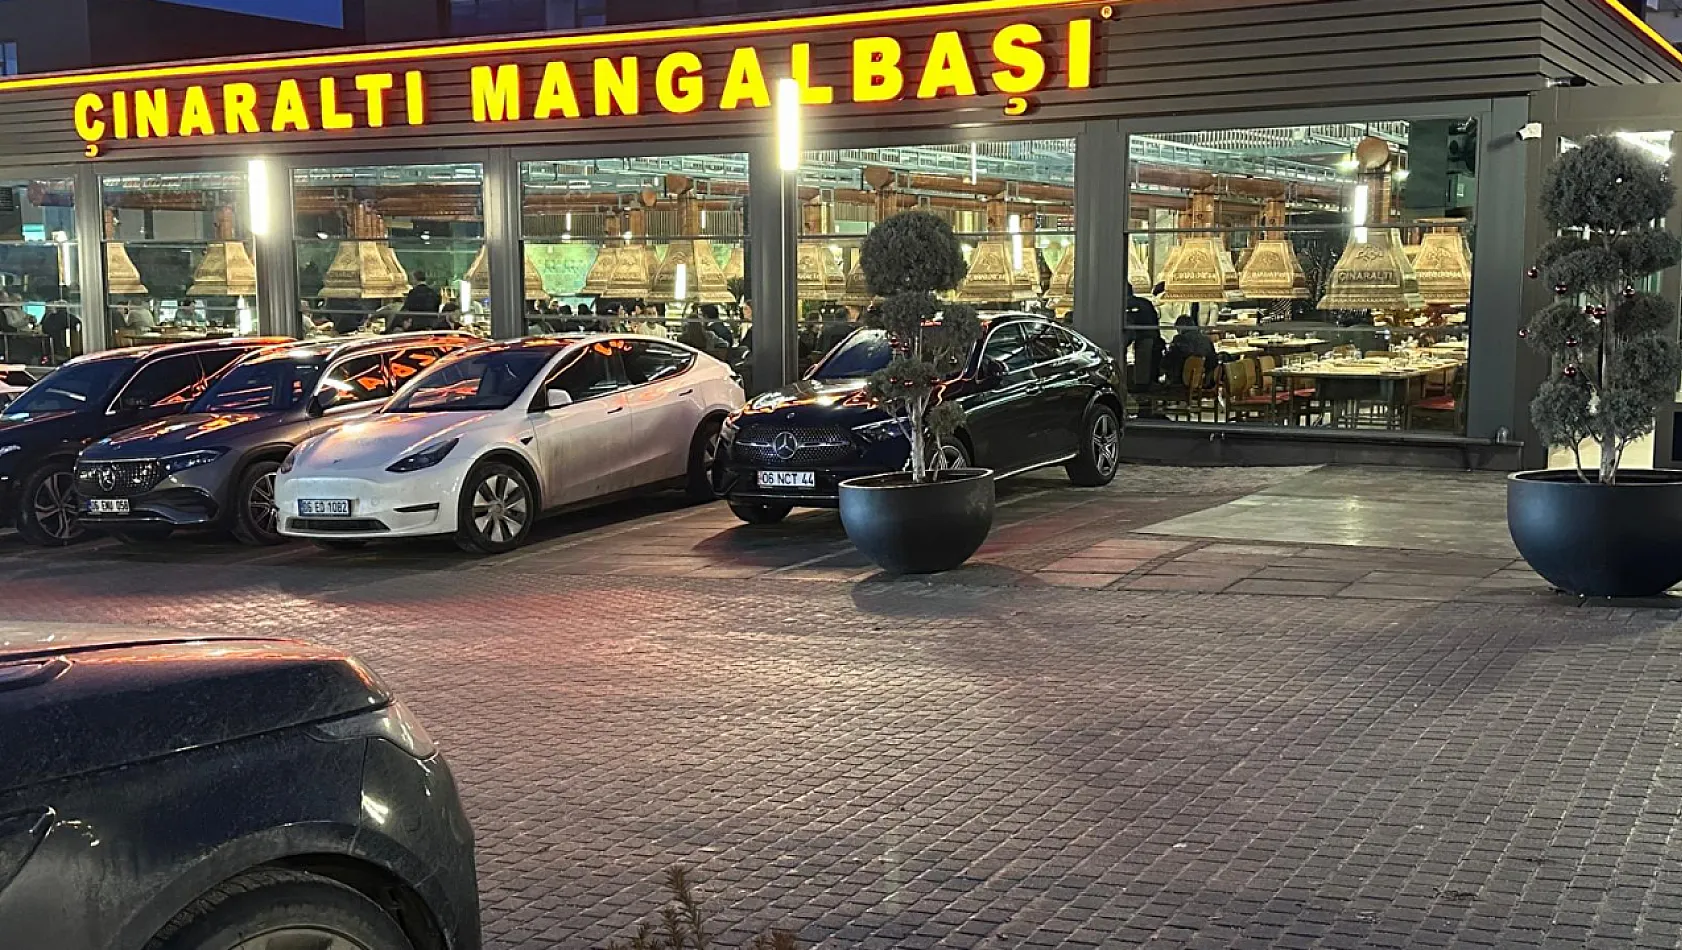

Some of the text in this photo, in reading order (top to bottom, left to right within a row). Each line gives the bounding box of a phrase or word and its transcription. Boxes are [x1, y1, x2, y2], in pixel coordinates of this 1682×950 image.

[74, 19, 1092, 157] ÇINARALTI MANGALBAŞI
[763, 472, 814, 485] 06 NCT 44
